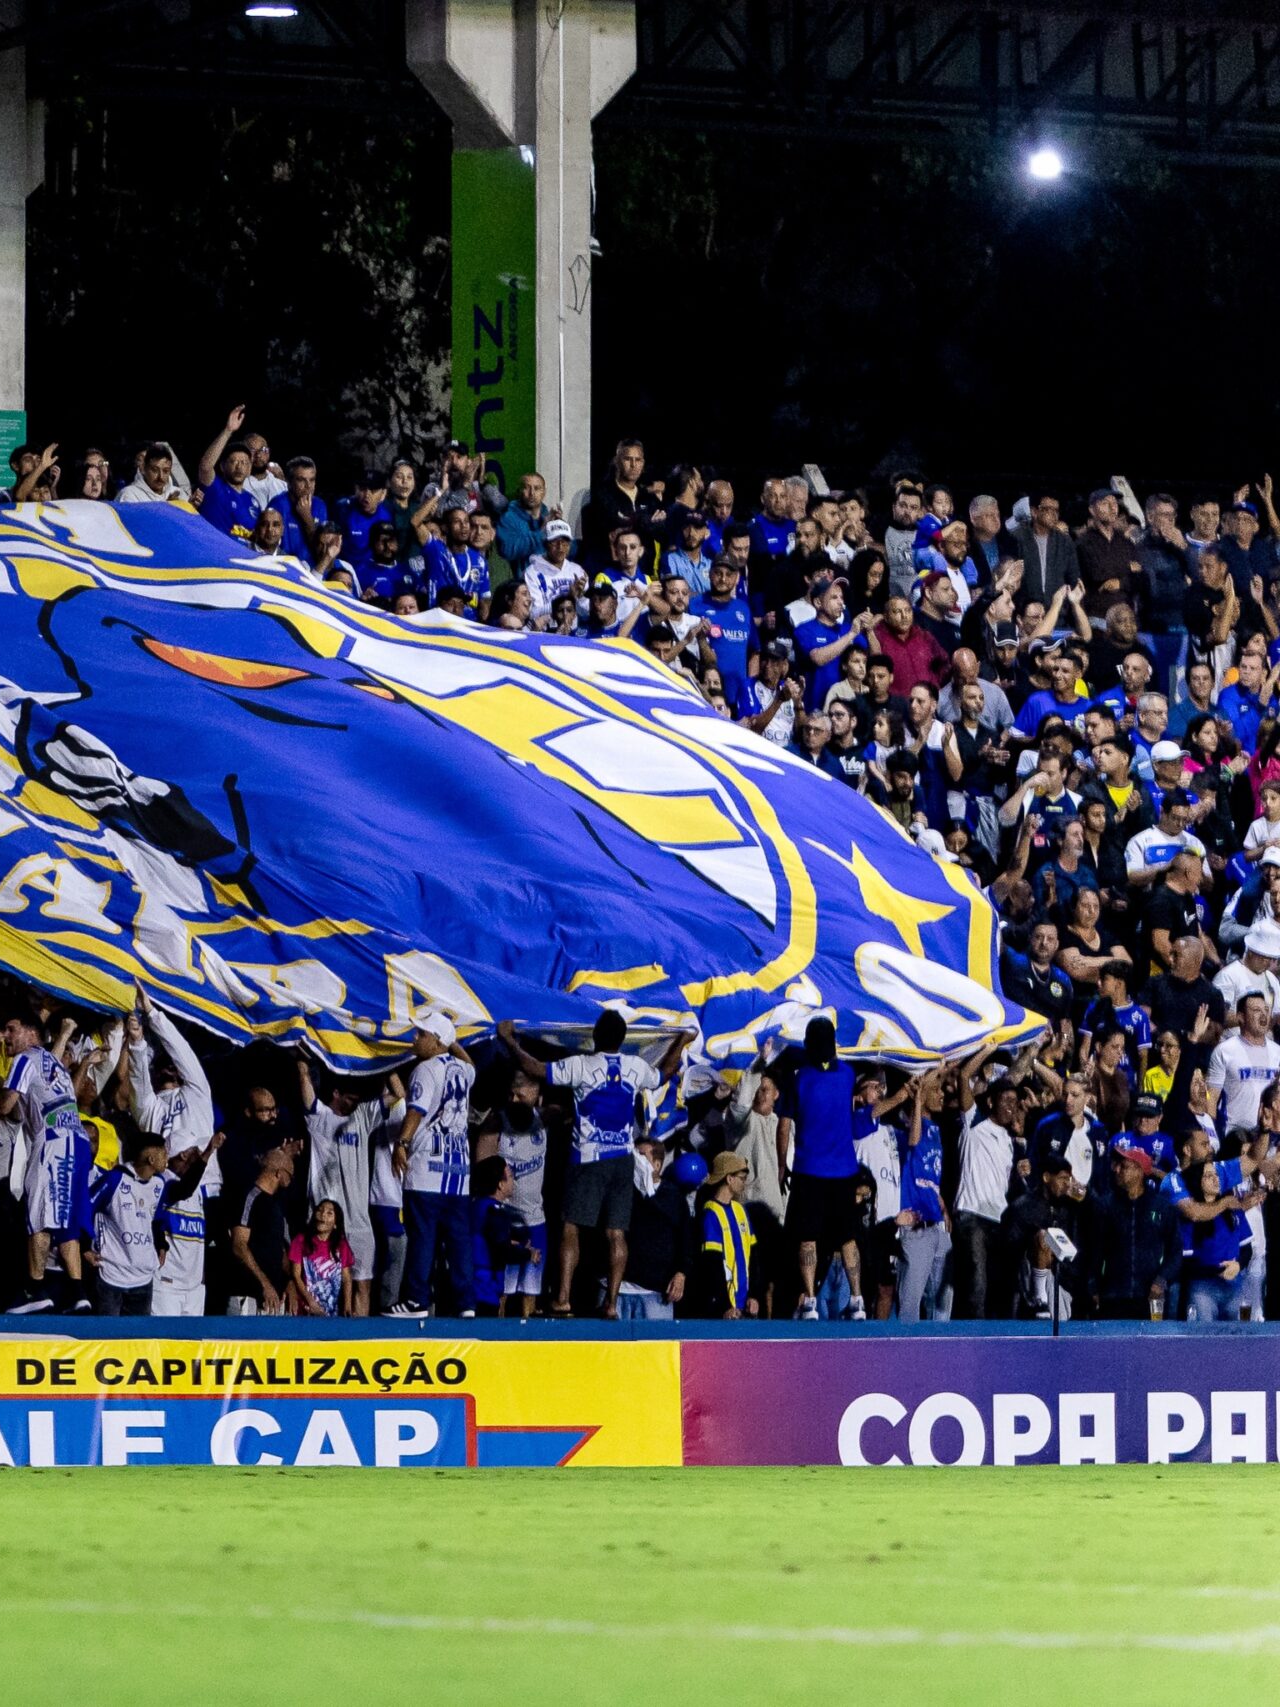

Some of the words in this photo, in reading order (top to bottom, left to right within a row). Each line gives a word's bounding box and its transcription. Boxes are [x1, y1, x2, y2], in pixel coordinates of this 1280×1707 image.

[468, 301, 506, 498] ntz
[16, 1358, 77, 1386] DE
[93, 1352, 468, 1393] CAPITALIZAÇÃO
[209, 1408, 439, 1467] CAP
[837, 1391, 1116, 1466] COPA
[1146, 1390, 1280, 1464] PA
